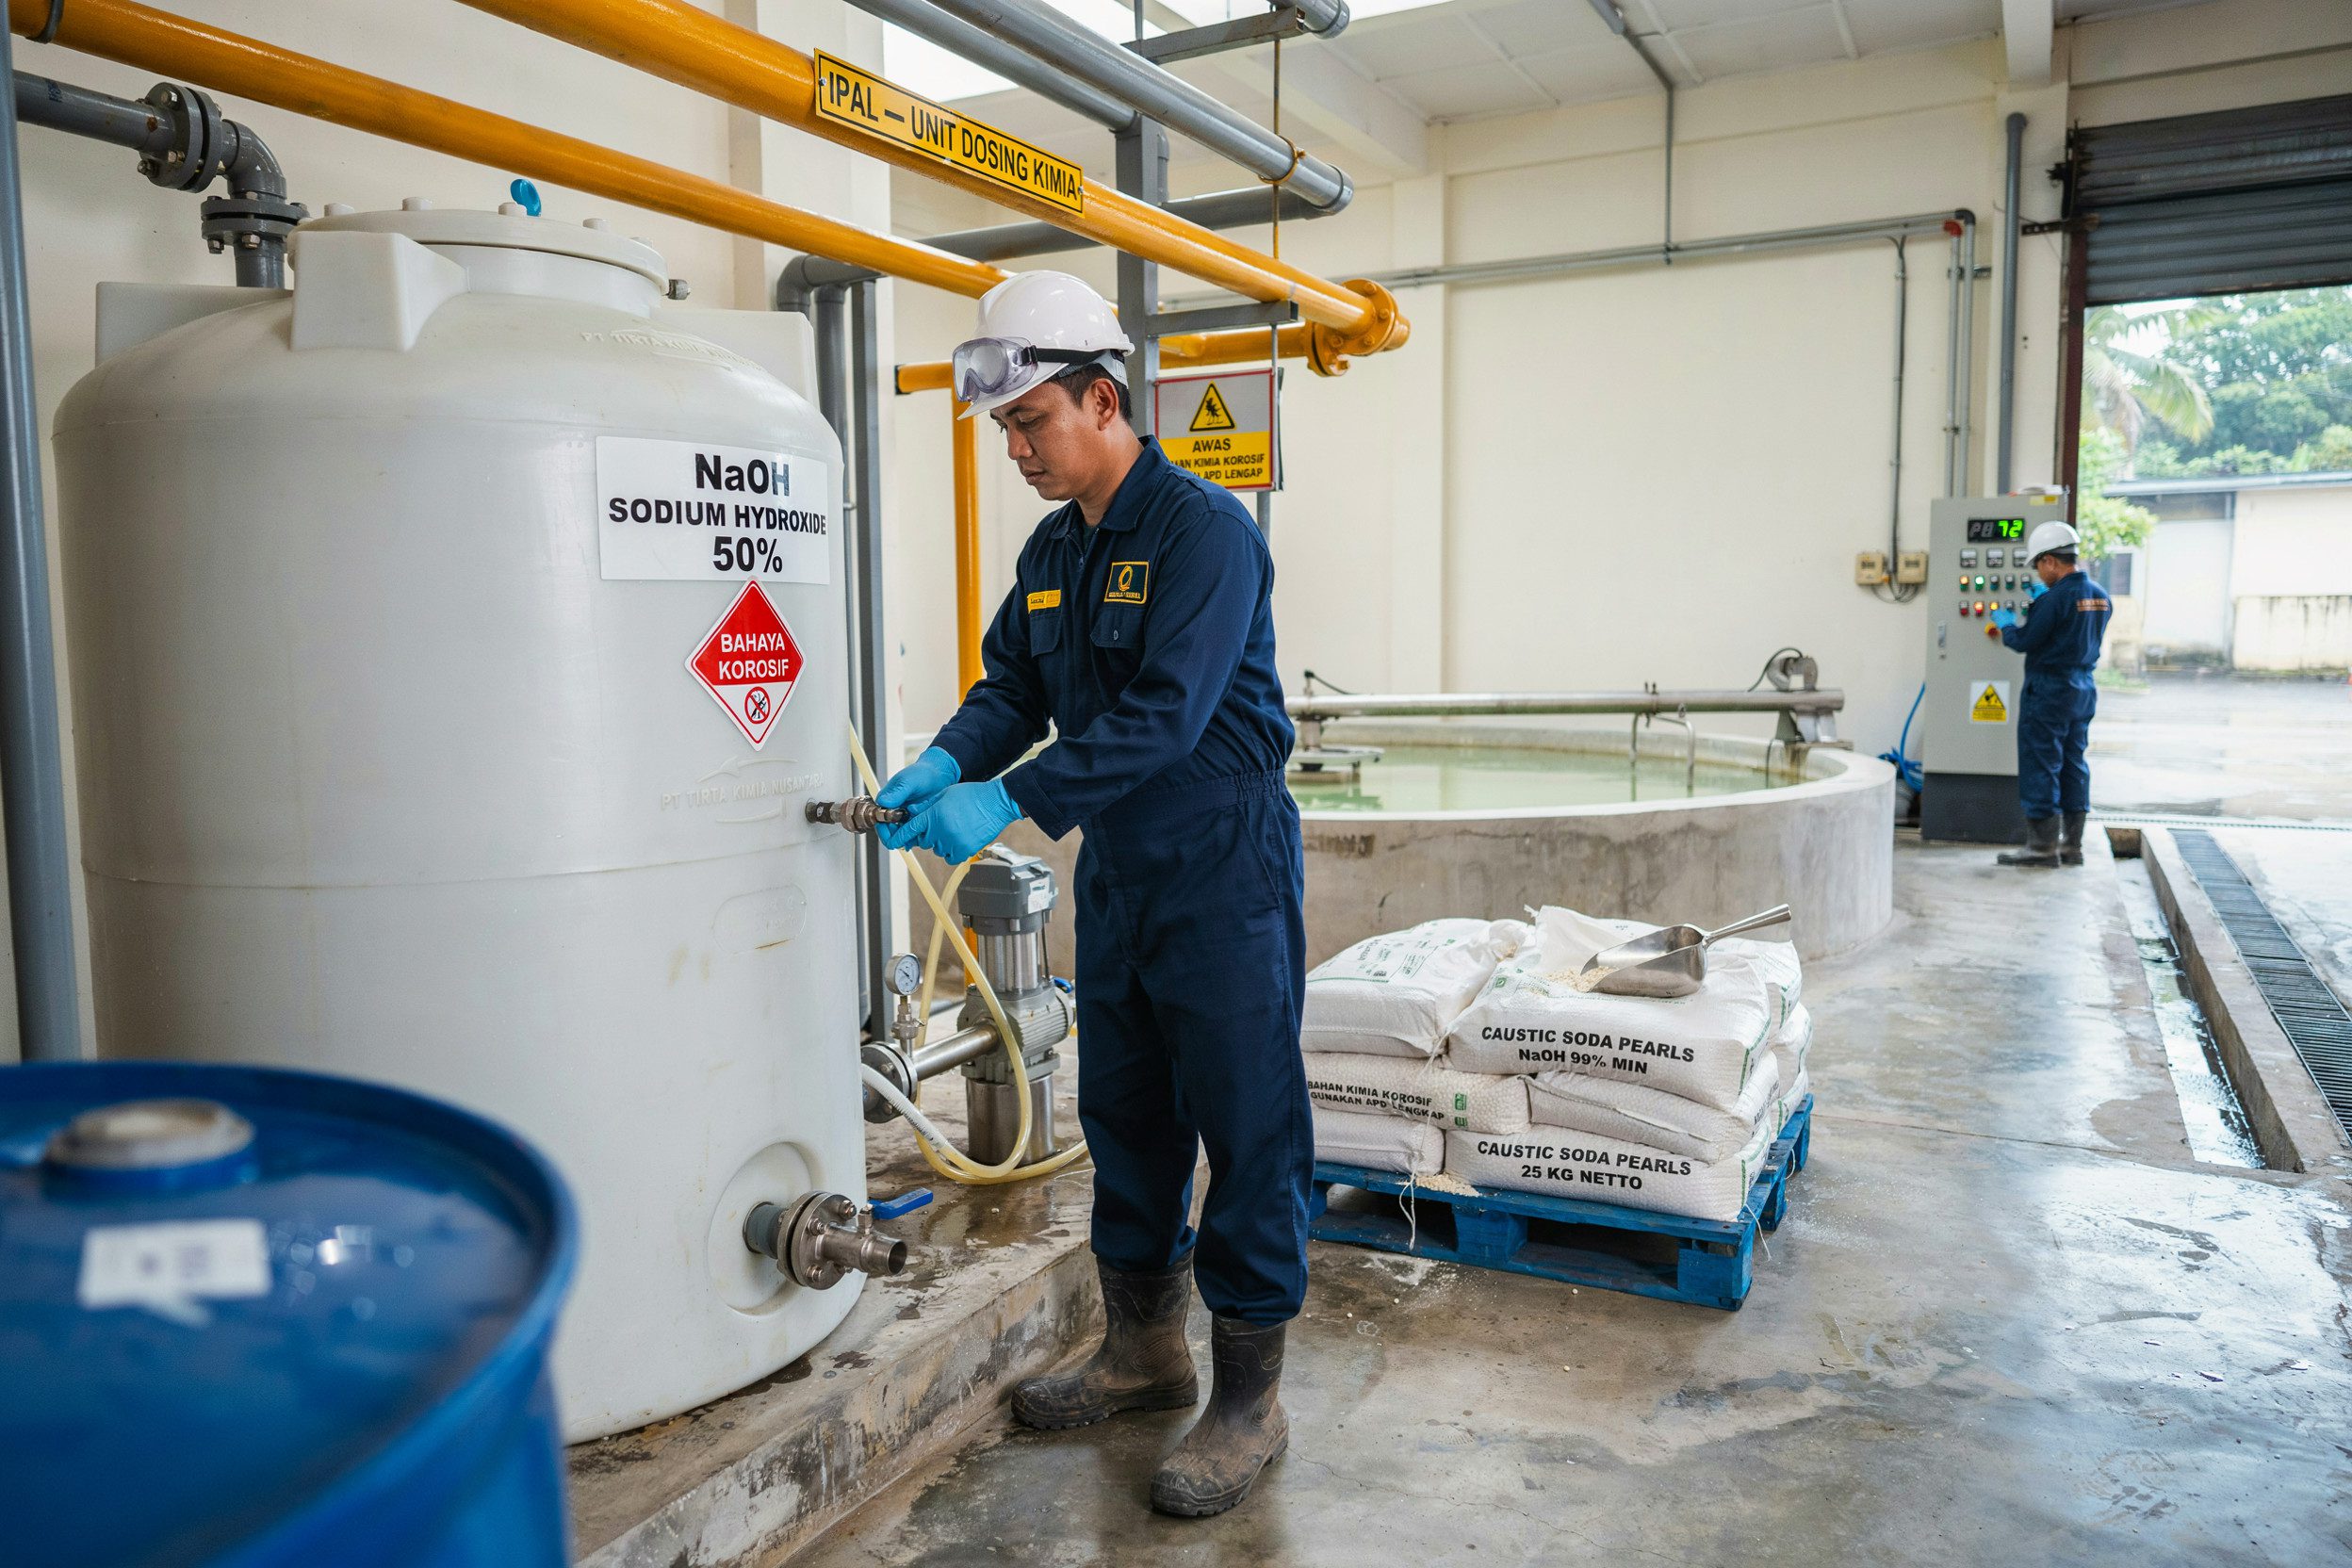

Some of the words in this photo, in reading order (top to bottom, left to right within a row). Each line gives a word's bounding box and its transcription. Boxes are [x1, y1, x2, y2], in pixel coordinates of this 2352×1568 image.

[829, 71, 878, 122] IPAL
[911, 106, 956, 151] UNIT
[961, 128, 1028, 181] DOSING
[1033, 158, 1077, 200] KIMIA
[1193, 438, 1231, 452] AWAS
[1194, 458, 1221, 467] KIMIA
[1223, 454, 1265, 466] KOROSIF
[695, 452, 790, 497] NaOH
[1204, 471, 1221, 481] APD
[1225, 468, 1263, 479] LENGAP
[609, 498, 726, 526] SODIUM
[735, 505, 826, 535] HYDROXIDE
[1999, 520, 2022, 537] 72
[712, 536, 782, 573] 50%
[721, 633, 785, 652] BAHAYA
[718, 659, 790, 679] KOROSIF
[662, 792, 680, 810] PT
[687, 788, 727, 808] TIRTA
[733, 781, 768, 801] KIMIA
[771, 773, 825, 794] NUSANTARA
[1481, 1027, 1557, 1042] CAUSTIC
[1562, 1031, 1613, 1049] SODA
[1619, 1037, 1694, 1063] PEARLS
[1519, 1049, 1565, 1063] NaOH
[1571, 1052, 1606, 1067] 99%
[1612, 1057, 1647, 1073] MIN
[1308, 1081, 1342, 1092] BAHAN
[1347, 1086, 1378, 1097] KIMIA
[1382, 1090, 1432, 1106] KOROSIF
[1310, 1091, 1362, 1105] GUNAKAN
[1366, 1099, 1387, 1108] APD
[1392, 1102, 1445, 1119] LENGKAP
[1478, 1140, 1554, 1159] CAUSTIC
[1560, 1148, 1609, 1165] SODA
[1617, 1155, 1691, 1176] PEARLS
[1522, 1165, 1542, 1178] 25
[1547, 1167, 1574, 1182] KG
[1580, 1170, 1643, 1189] NETTO
